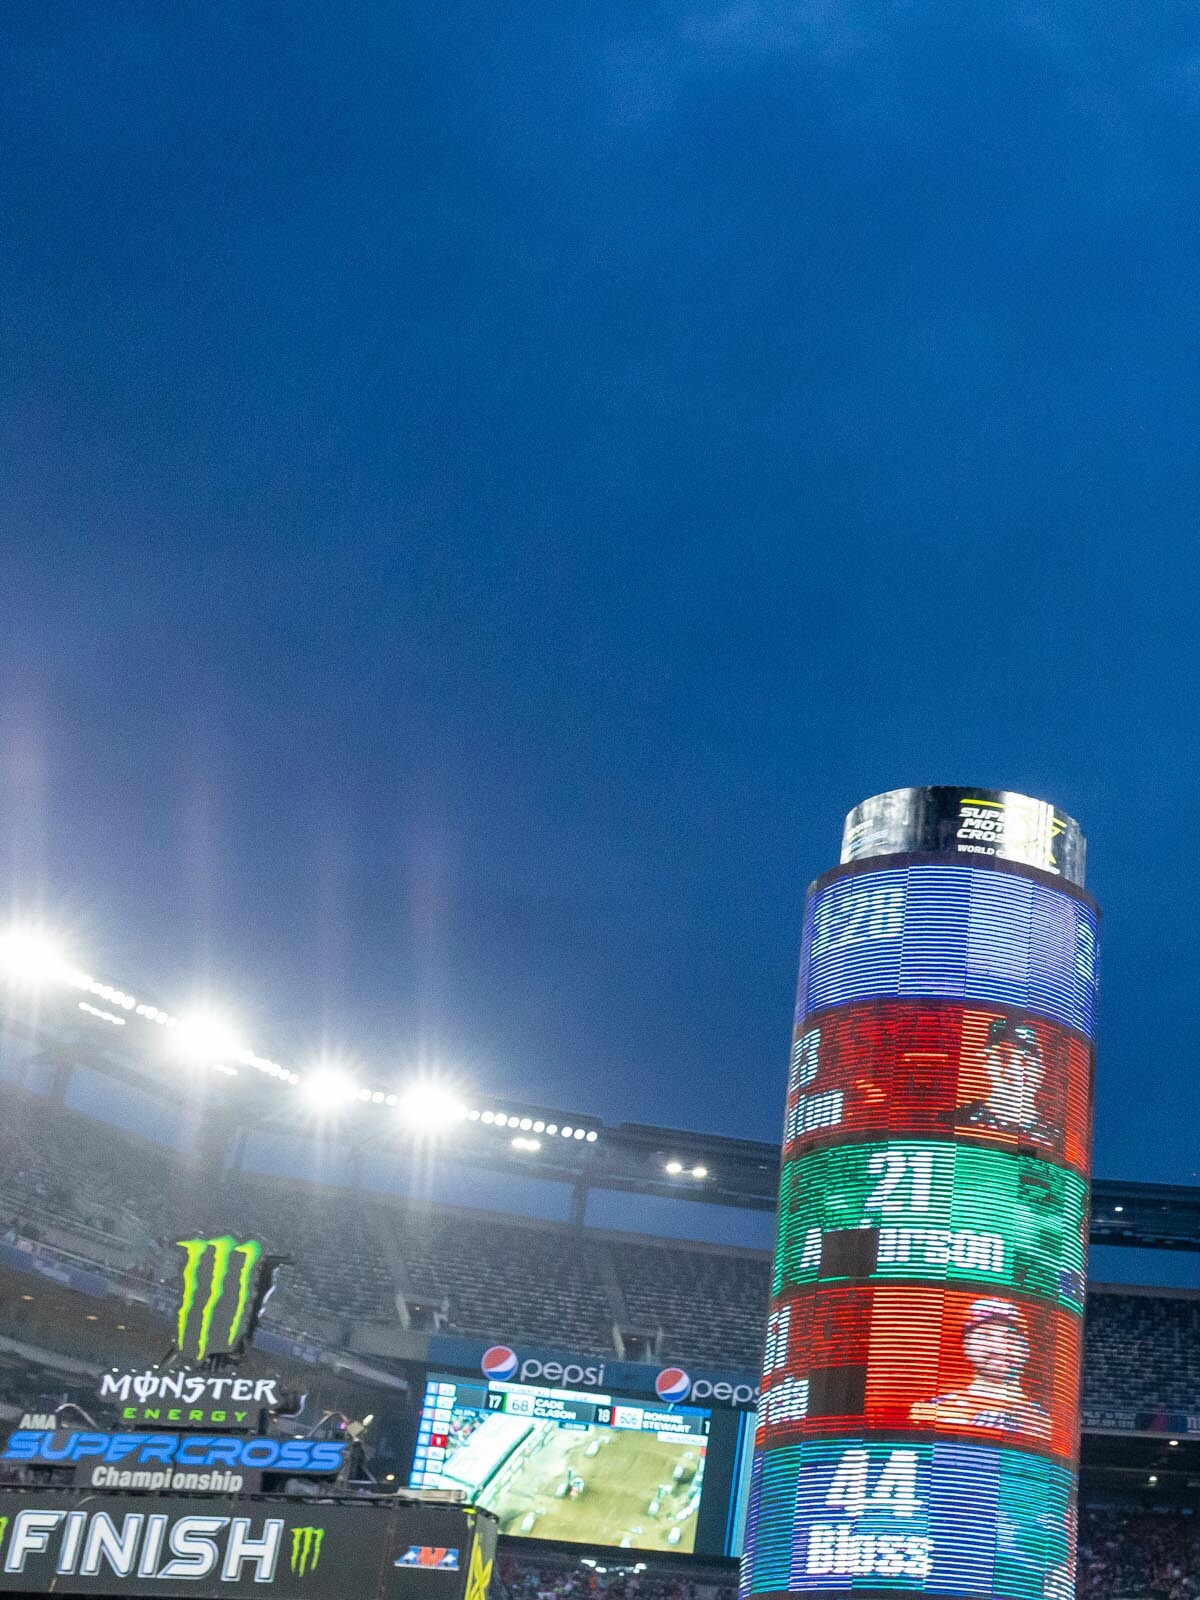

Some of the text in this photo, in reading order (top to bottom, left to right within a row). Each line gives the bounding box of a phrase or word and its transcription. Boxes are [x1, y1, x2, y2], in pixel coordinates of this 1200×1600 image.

[956, 829, 1007, 843] CROS
[962, 818, 1007, 833] MOT
[957, 845, 995, 855] WORLD
[864, 1151, 933, 1214] 21
[798, 1217, 1004, 1274] Aerson
[520, 1358, 605, 1387] pepsi
[101, 1370, 279, 1405] MONSTER
[691, 1377, 761, 1406] peps
[19, 1413, 58, 1430] AMA
[123, 1407, 248, 1423] ENERGY
[488, 1394, 503, 1409] 17
[511, 1400, 529, 1412] 68
[535, 1399, 565, 1411] CADE
[598, 1408, 611, 1422] 18
[533, 1408, 577, 1421] CLASON
[3, 1431, 348, 1471] SUPERCROSS
[91, 1465, 243, 1492] Championship
[825, 1449, 923, 1518] 44
[4, 1508, 286, 1583] FINISH
[806, 1522, 934, 1578] Bloss
